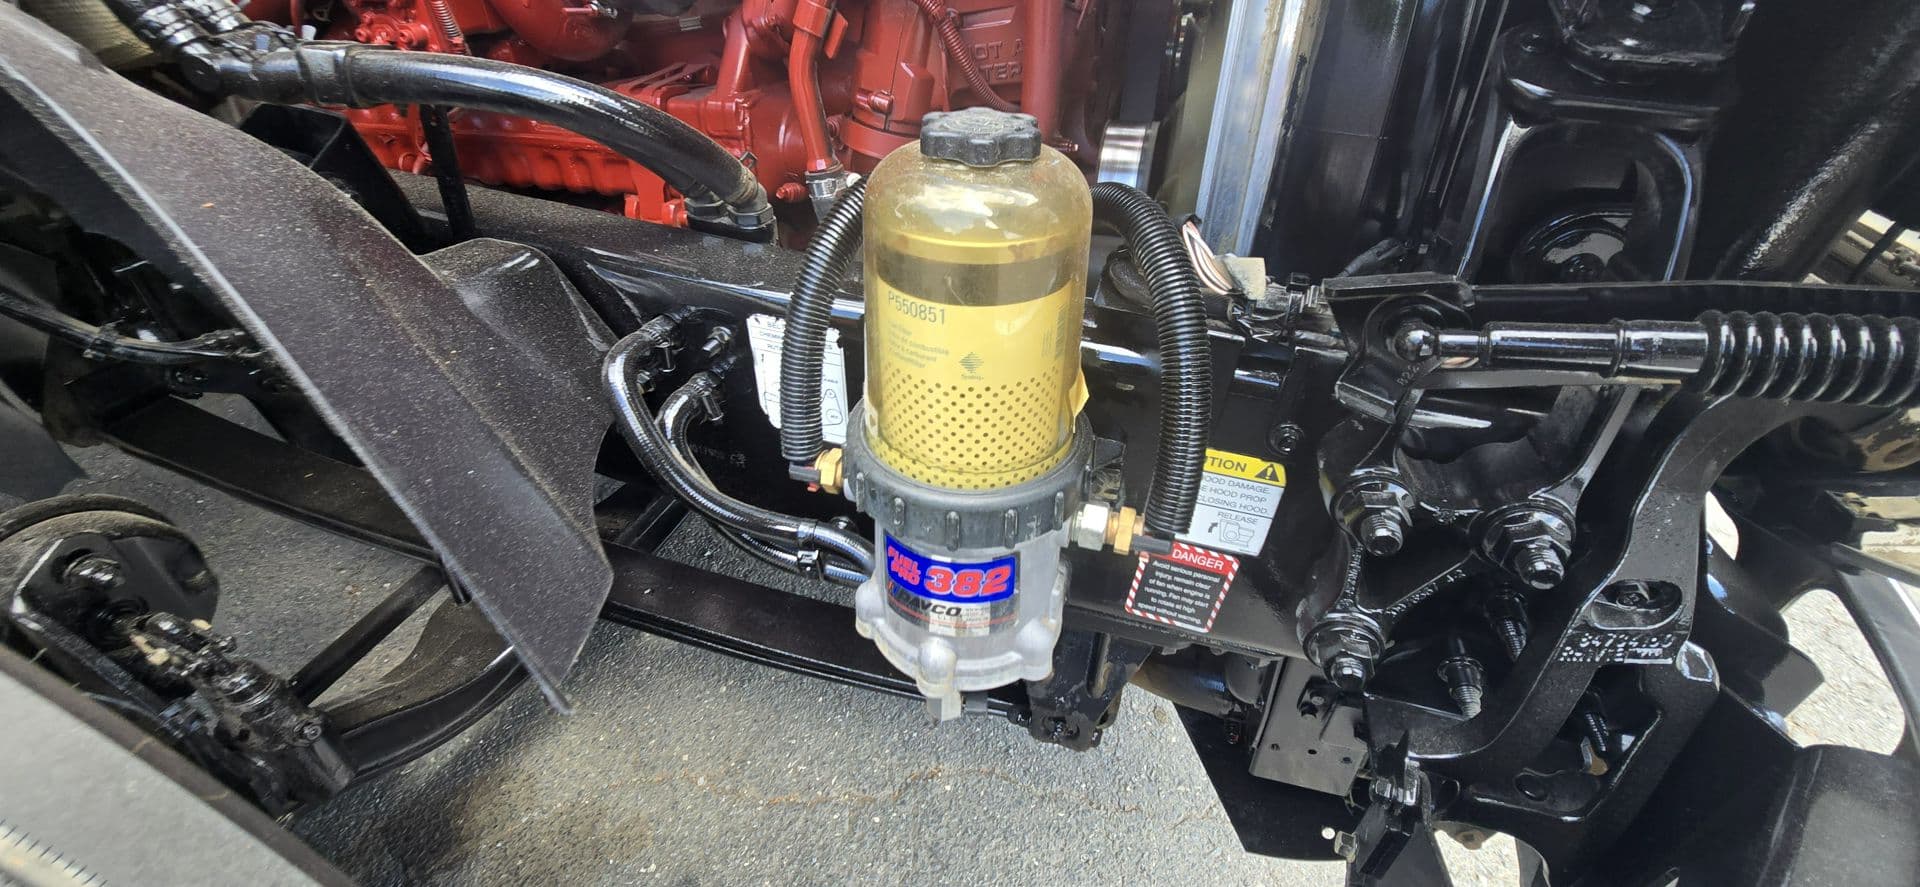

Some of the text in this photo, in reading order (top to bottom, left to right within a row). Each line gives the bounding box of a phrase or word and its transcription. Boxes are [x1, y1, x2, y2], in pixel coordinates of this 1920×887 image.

[888, 290, 945, 325] P550851
[1209, 456, 1247, 472] TION
[1205, 475, 1226, 485] OOD
[1209, 487, 1238, 498] HOOD
[1240, 493, 1267, 503] PROP
[1217, 511, 1259, 524] RELEASE
[1172, 549, 1224, 570] DANGER
[1152, 560, 1220, 583] Avoid serious personal
[924, 565, 1011, 597] 382
[1156, 579, 1166, 587] fan
[1166, 582, 1183, 592] when
[1183, 587, 1204, 598] engine
[1173, 576, 1195, 586] remain
[1195, 581, 1211, 590] clear
[1157, 599, 1175, 608] rotate
[1175, 602, 1182, 610] at
[1182, 604, 1196, 614] high
[1168, 592, 1180, 601] Fan
[1181, 596, 1194, 605] may
[1194, 599, 1209, 608] start
[1137, 602, 1156, 612] speed
[1156, 606, 1178, 617] without
